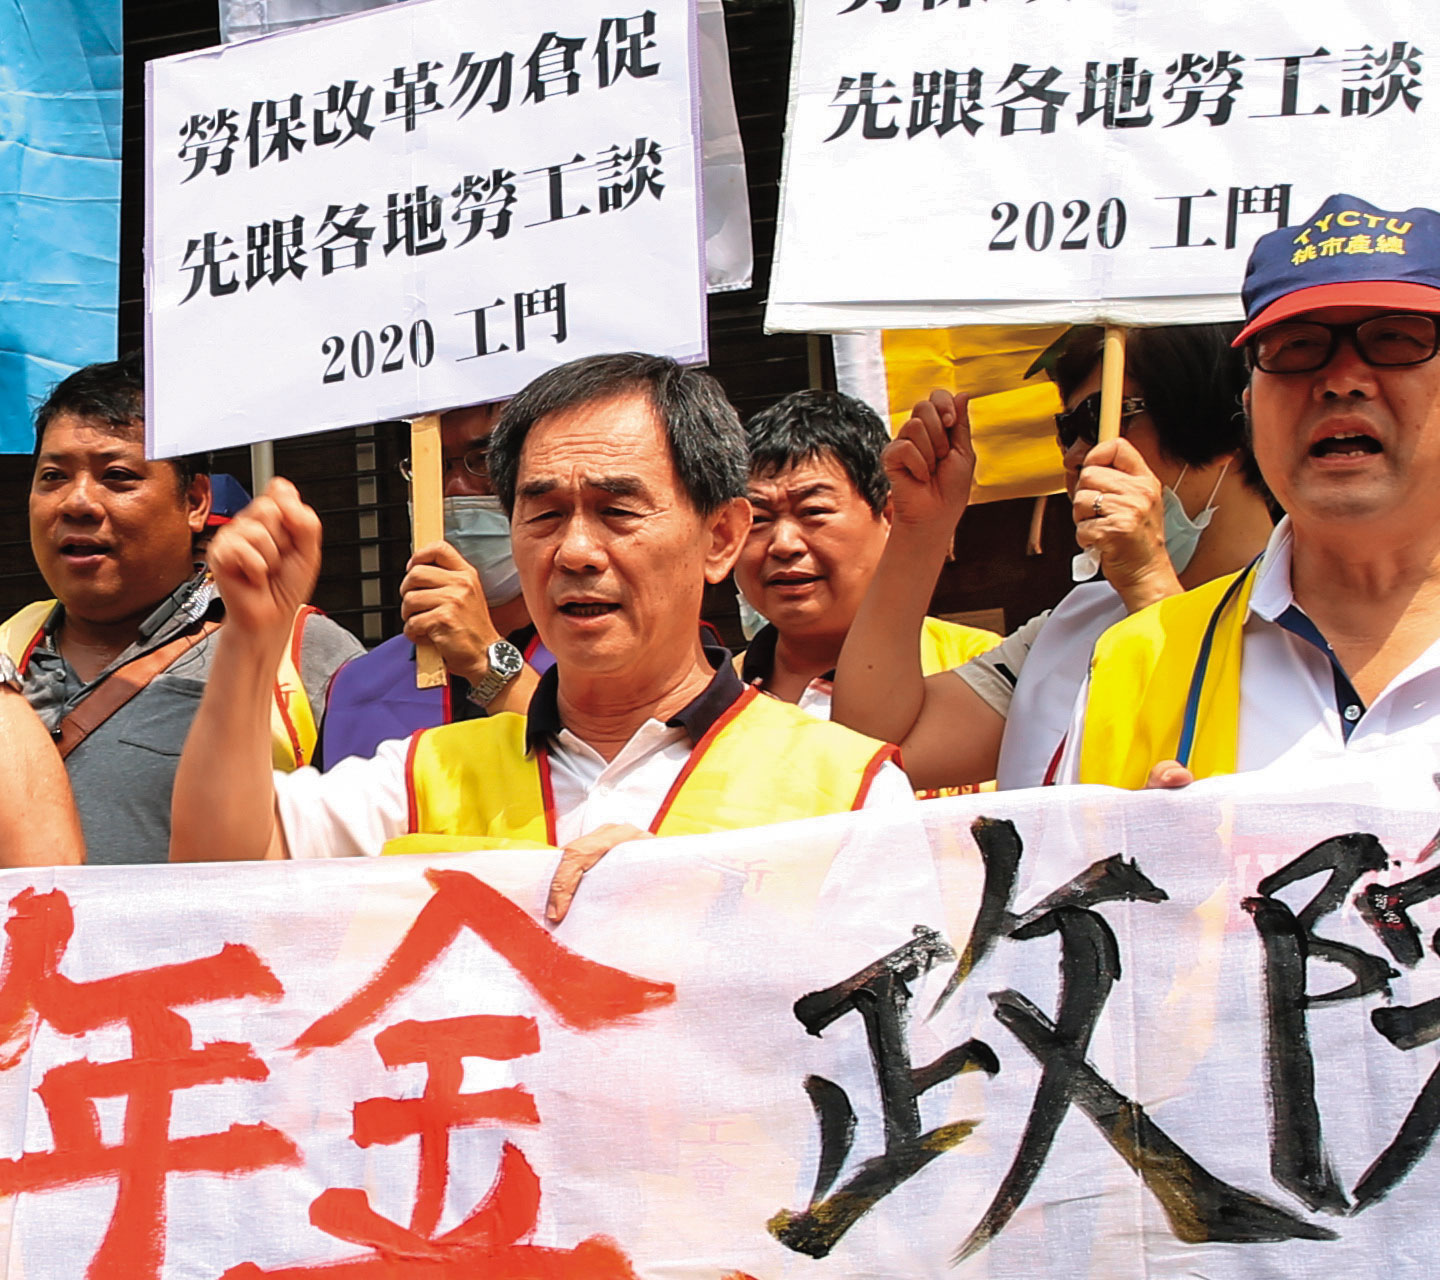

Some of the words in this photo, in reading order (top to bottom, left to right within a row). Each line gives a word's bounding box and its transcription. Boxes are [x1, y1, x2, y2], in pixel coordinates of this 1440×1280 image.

[178, 10, 660, 184] 勞保改革勿倉促
[823, 40, 1424, 143] 先跟各地勞工談
[178, 138, 665, 306] 先跟各地勞工談
[987, 197, 1127, 252] 2020
[1293, 210, 1413, 245] TYCTU
[321, 319, 435, 384] 2020
